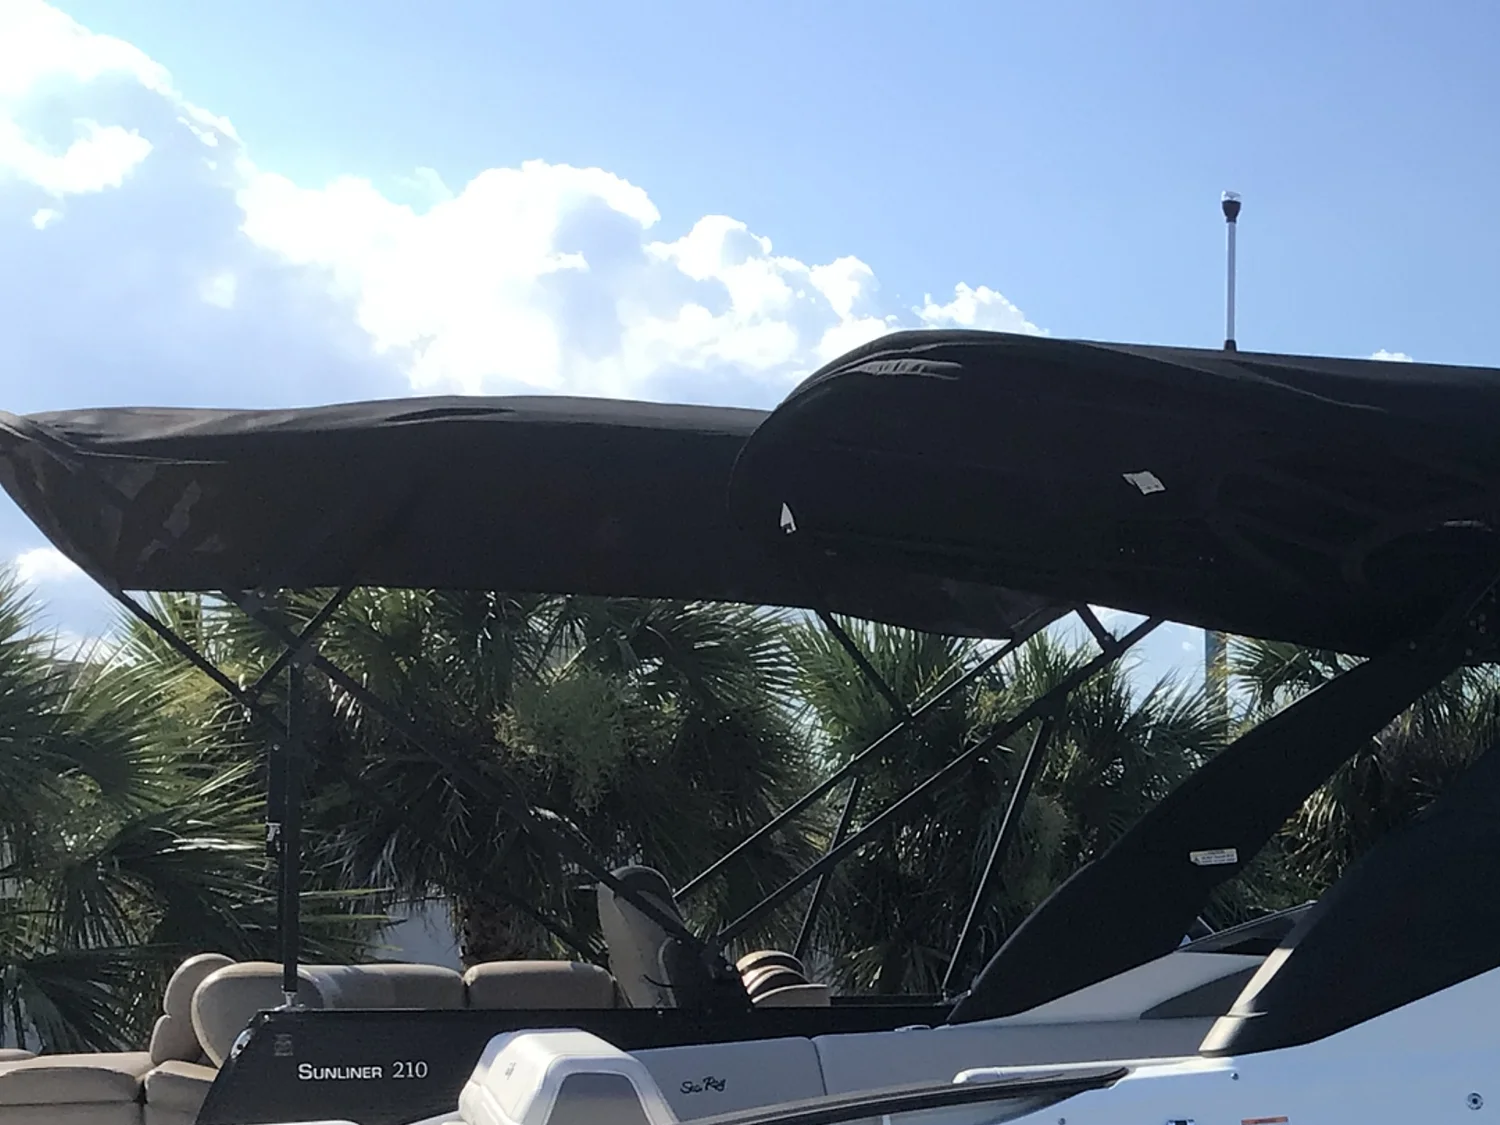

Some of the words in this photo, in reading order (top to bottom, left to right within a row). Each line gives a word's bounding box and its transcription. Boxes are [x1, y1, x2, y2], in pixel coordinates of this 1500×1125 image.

[392, 1061, 428, 1079] 210
[680, 1081, 702, 1094] Sea
[702, 1076, 727, 1092] Ray
